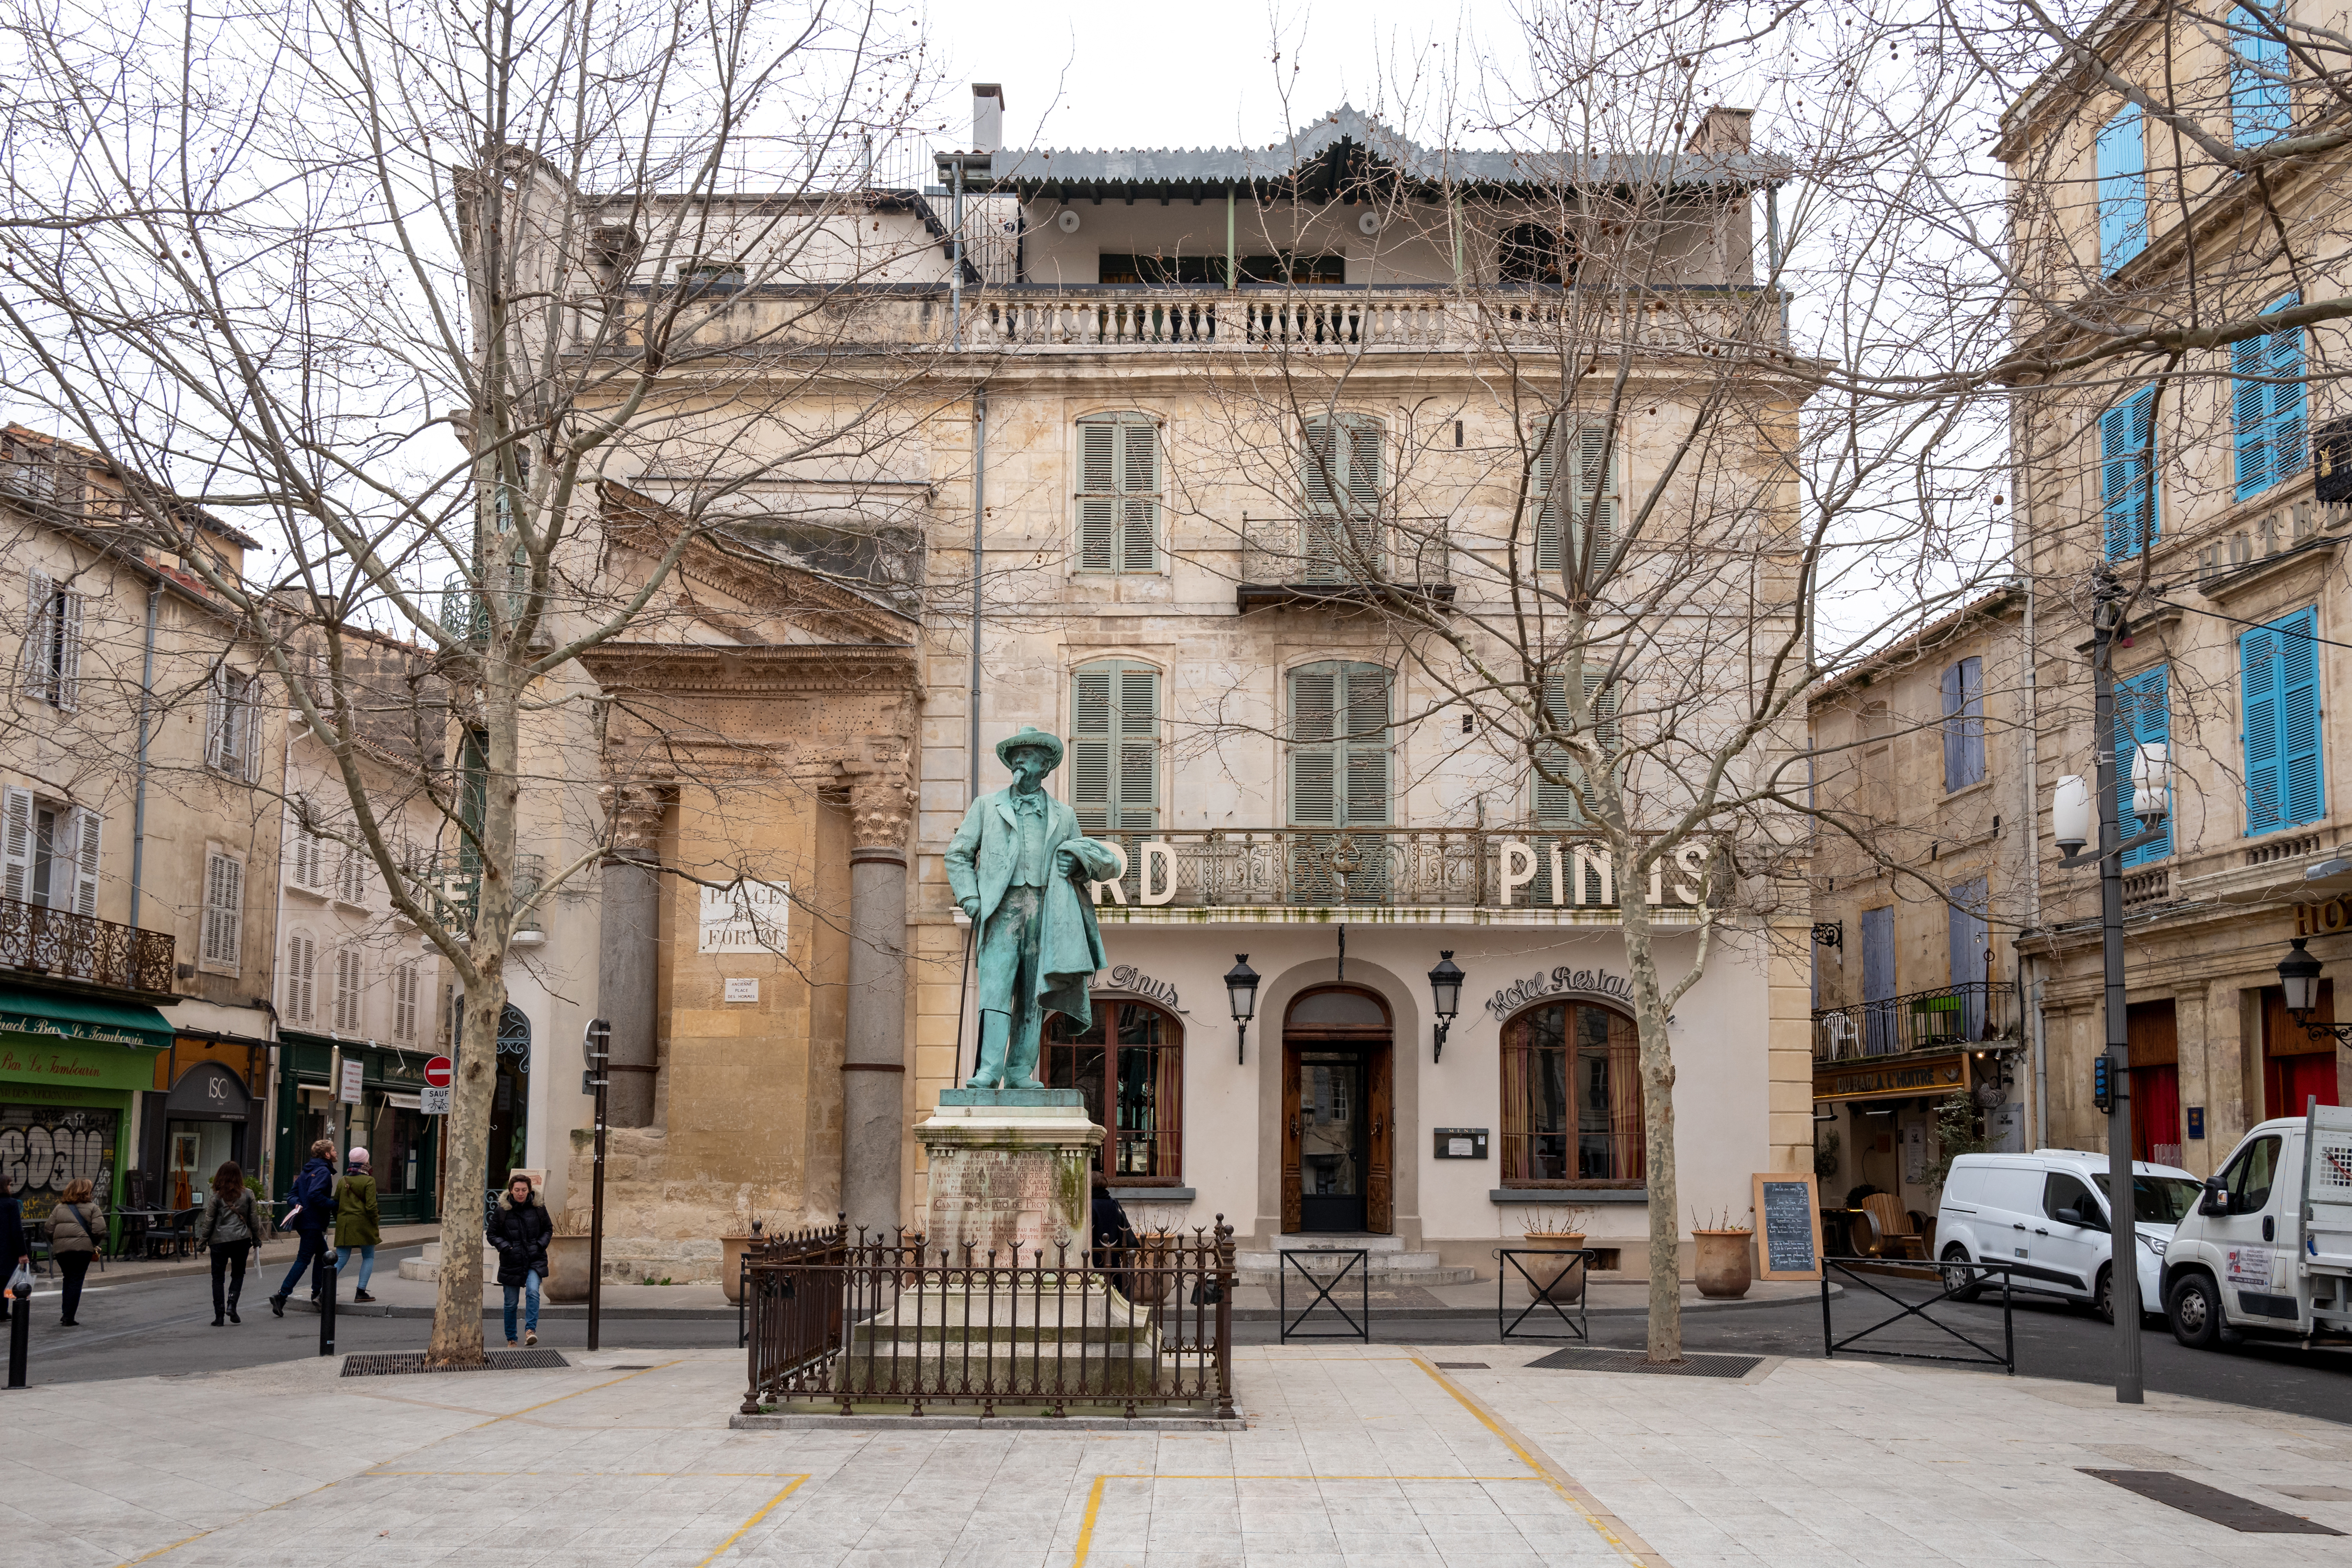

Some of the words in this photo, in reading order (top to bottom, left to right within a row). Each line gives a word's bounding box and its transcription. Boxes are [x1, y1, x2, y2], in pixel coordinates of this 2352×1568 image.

[710, 889, 779, 904] PLACE
[2293, 896, 2352, 937] HO
[709, 930, 778, 945] FORUM
[1107, 965, 1190, 1013] Pinus
[1486, 972, 1549, 1020] Hotel
[0, 1014, 27, 1031] nack
[34, 1019, 61, 1034] Bar
[72, 1023, 85, 1038] Le
[89, 1026, 144, 1045] Tambourin
[0, 1051, 22, 1071] Bar
[26, 1054, 43, 1073] Le
[46, 1055, 101, 1077] Tambourin
[405, 1067, 412, 1078] de
[209, 1077, 229, 1099] ISO
[1837, 1076, 1851, 1093] DU
[1853, 1075, 1874, 1091] BAR
[1877, 1073, 1884, 1090] A
[1887, 1067, 1935, 1089] L'HUITRE
